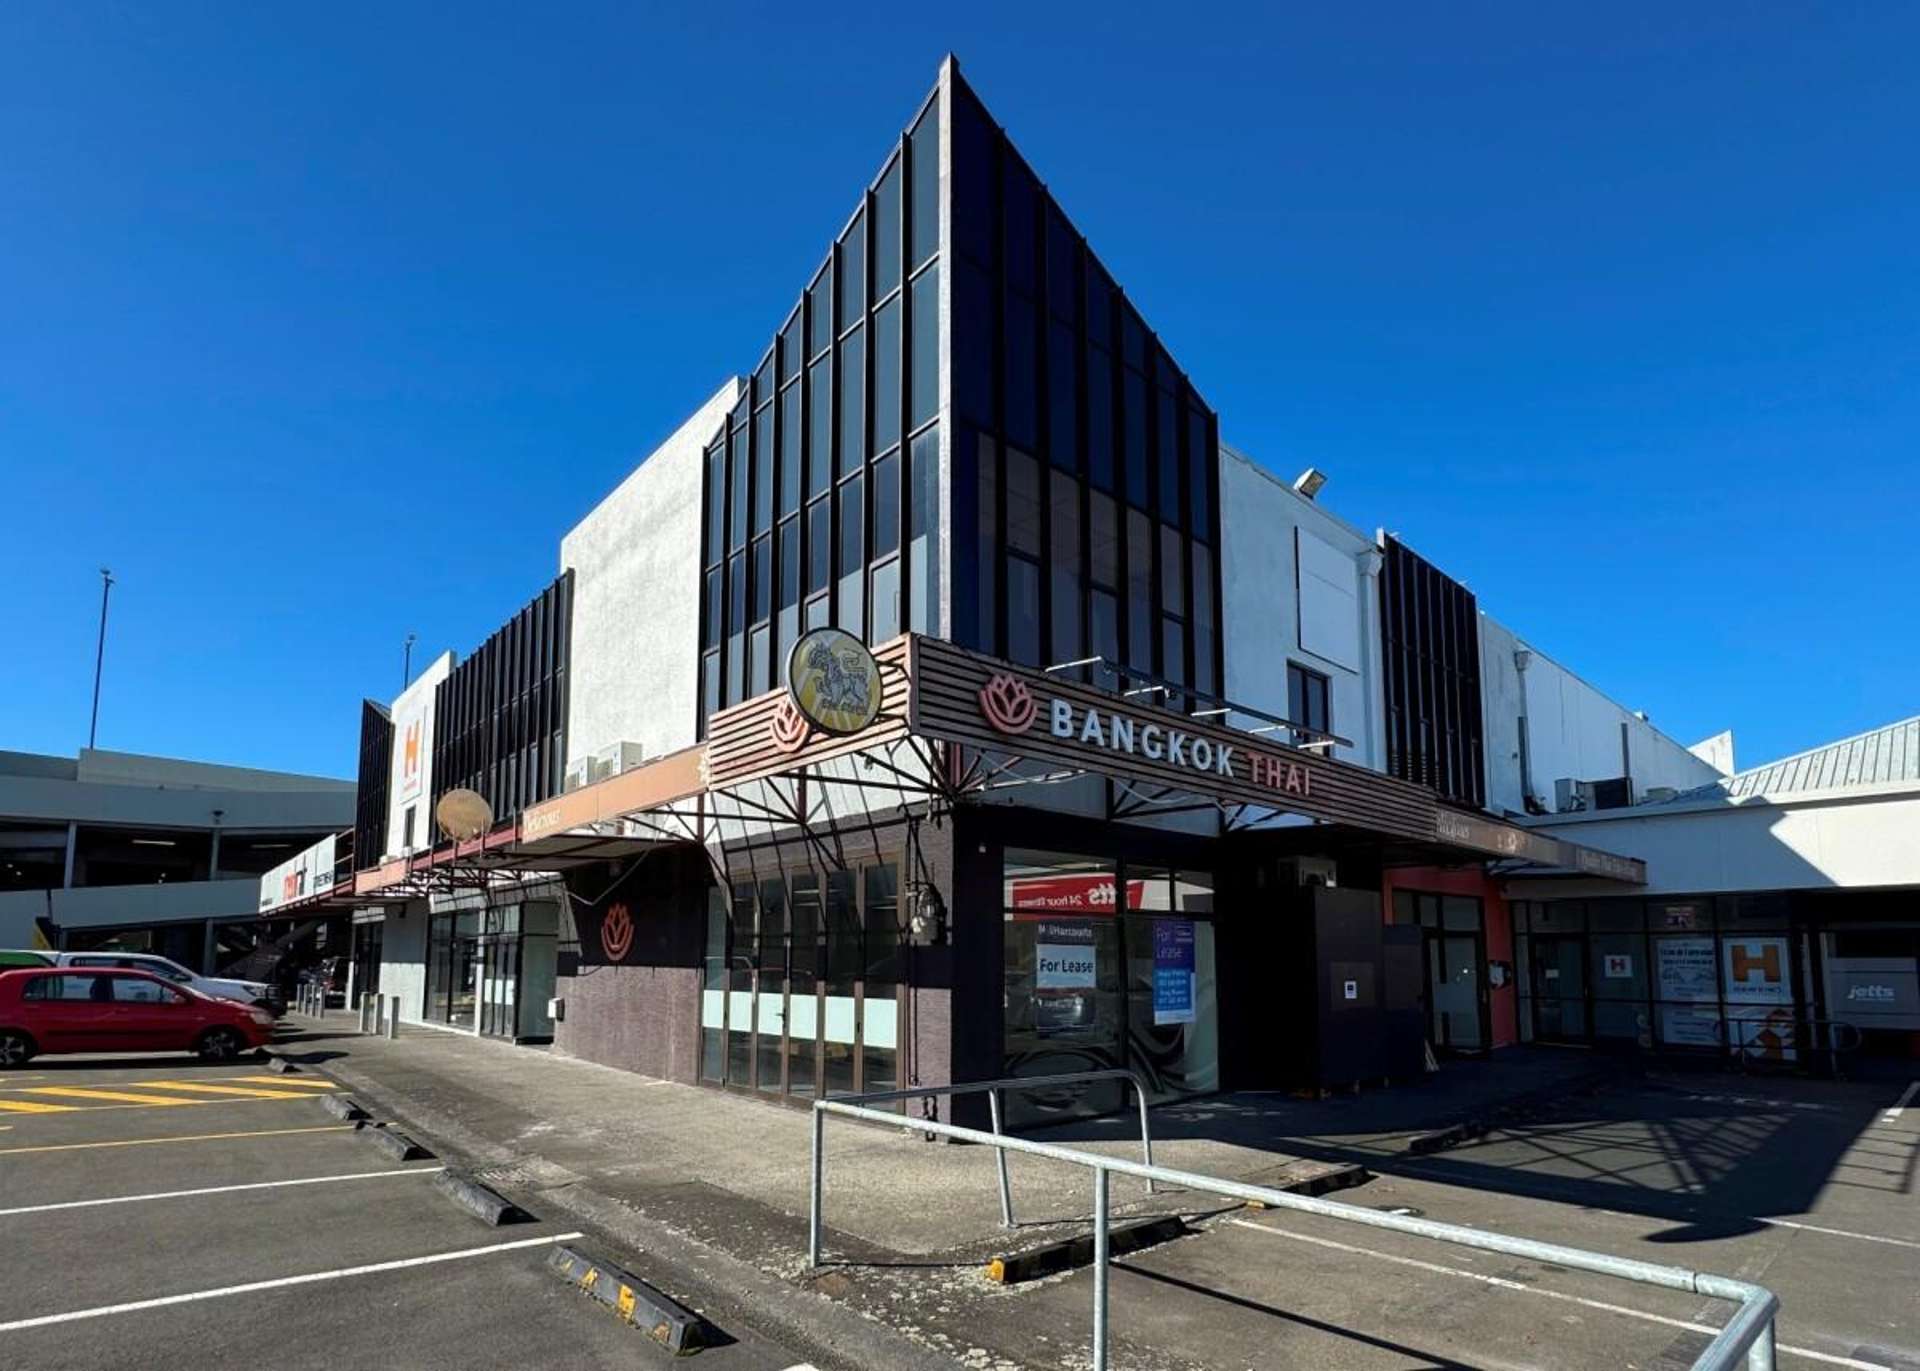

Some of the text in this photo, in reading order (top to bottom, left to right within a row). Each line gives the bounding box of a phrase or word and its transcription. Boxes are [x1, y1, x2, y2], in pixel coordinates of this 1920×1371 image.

[1051, 699, 1311, 796] BANGKOK THAI
[1040, 958, 1093, 973] For Lease
[1847, 984, 1896, 999] jetts
